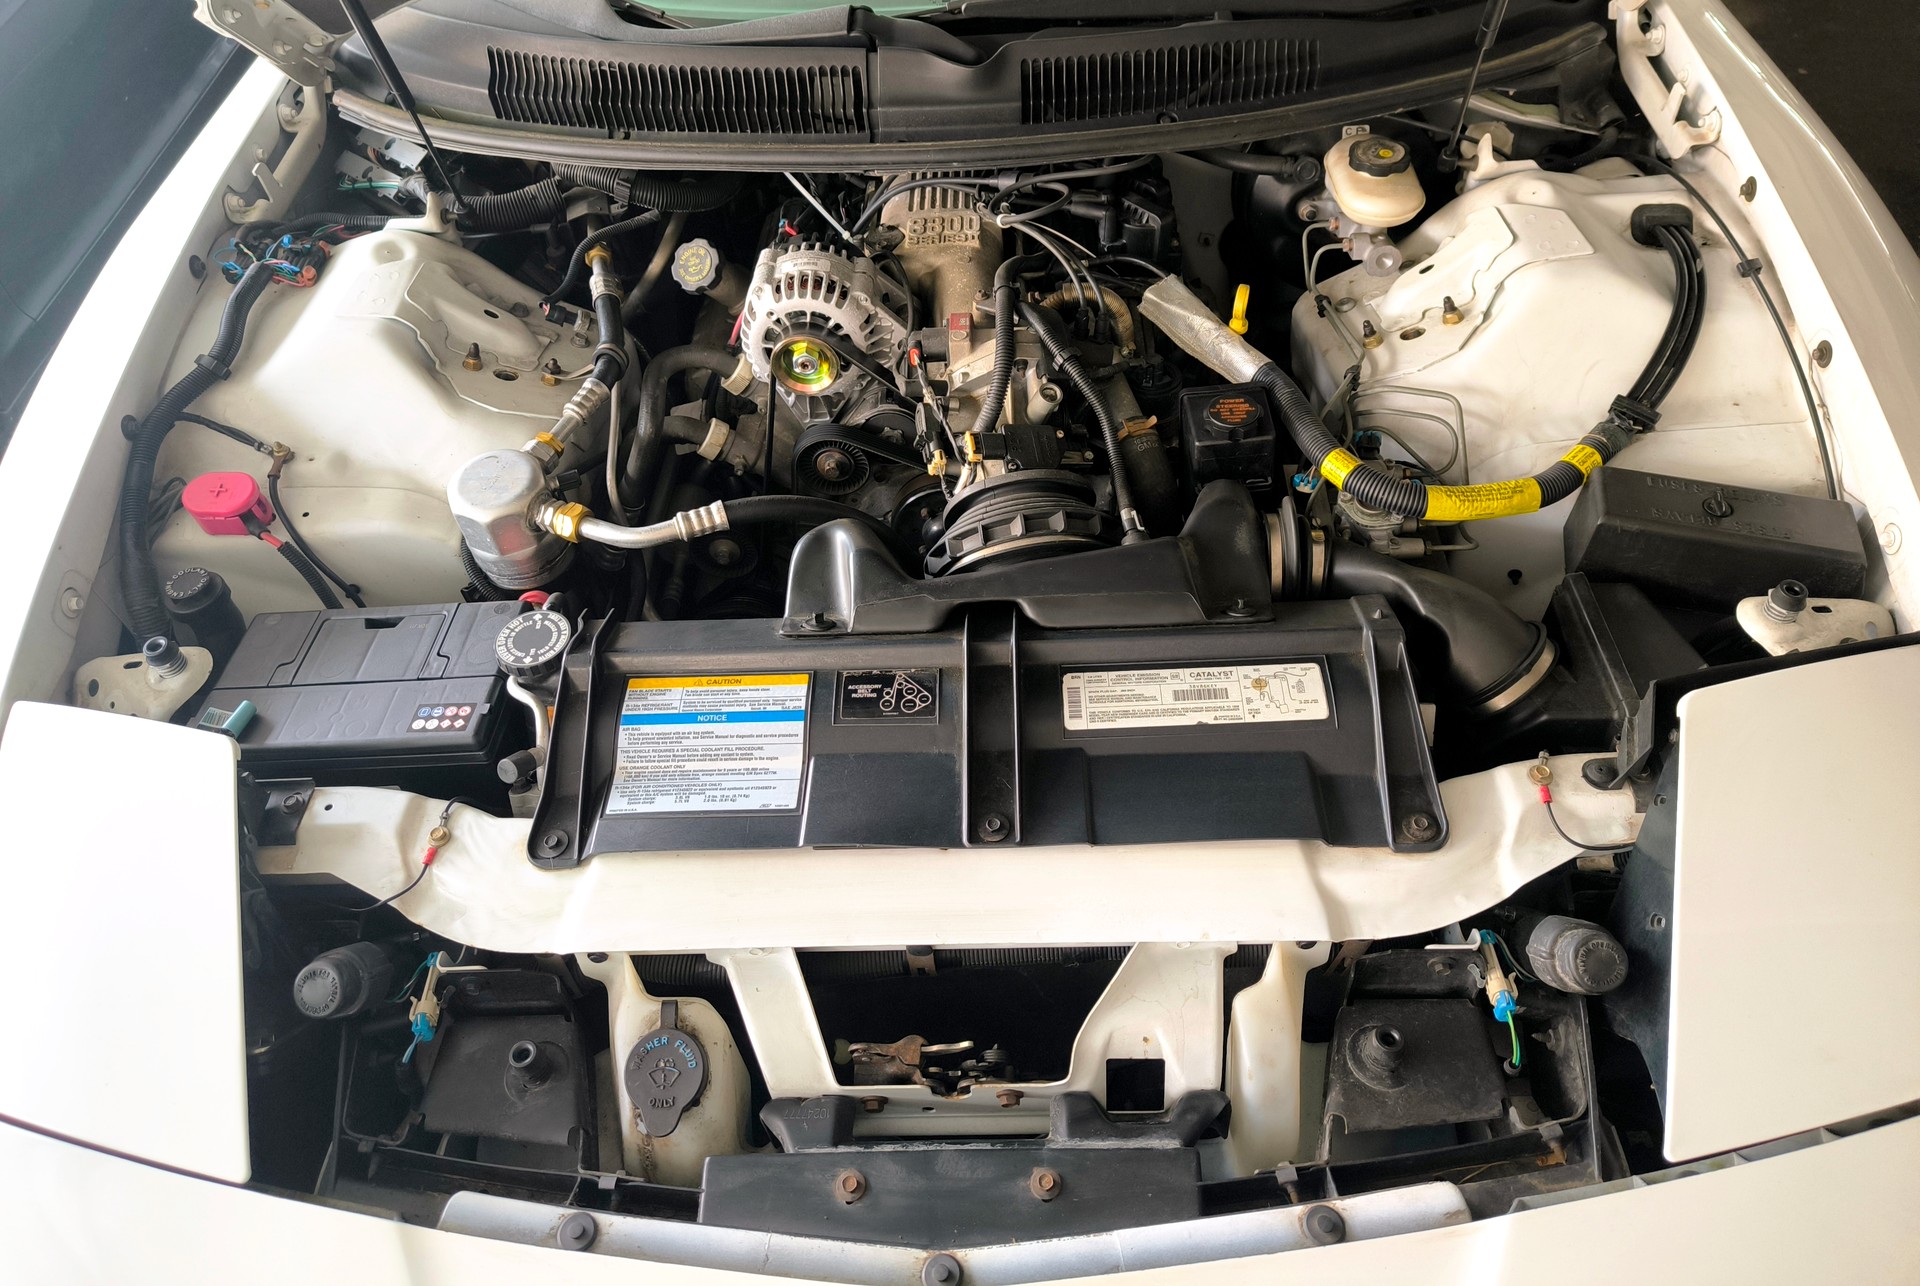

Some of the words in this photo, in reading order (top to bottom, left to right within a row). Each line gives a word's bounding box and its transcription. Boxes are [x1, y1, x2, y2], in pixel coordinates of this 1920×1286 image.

[908, 216, 981, 236] 3800
[173, 568, 208, 579] COOLANT
[508, 617, 523, 629] HOT
[498, 629, 511, 645] OPEN
[497, 646, 515, 662] NEVER
[631, 1036, 669, 1070] WASHER
[674, 1039, 698, 1069] FLUID
[648, 1096, 676, 1108] ONLY
